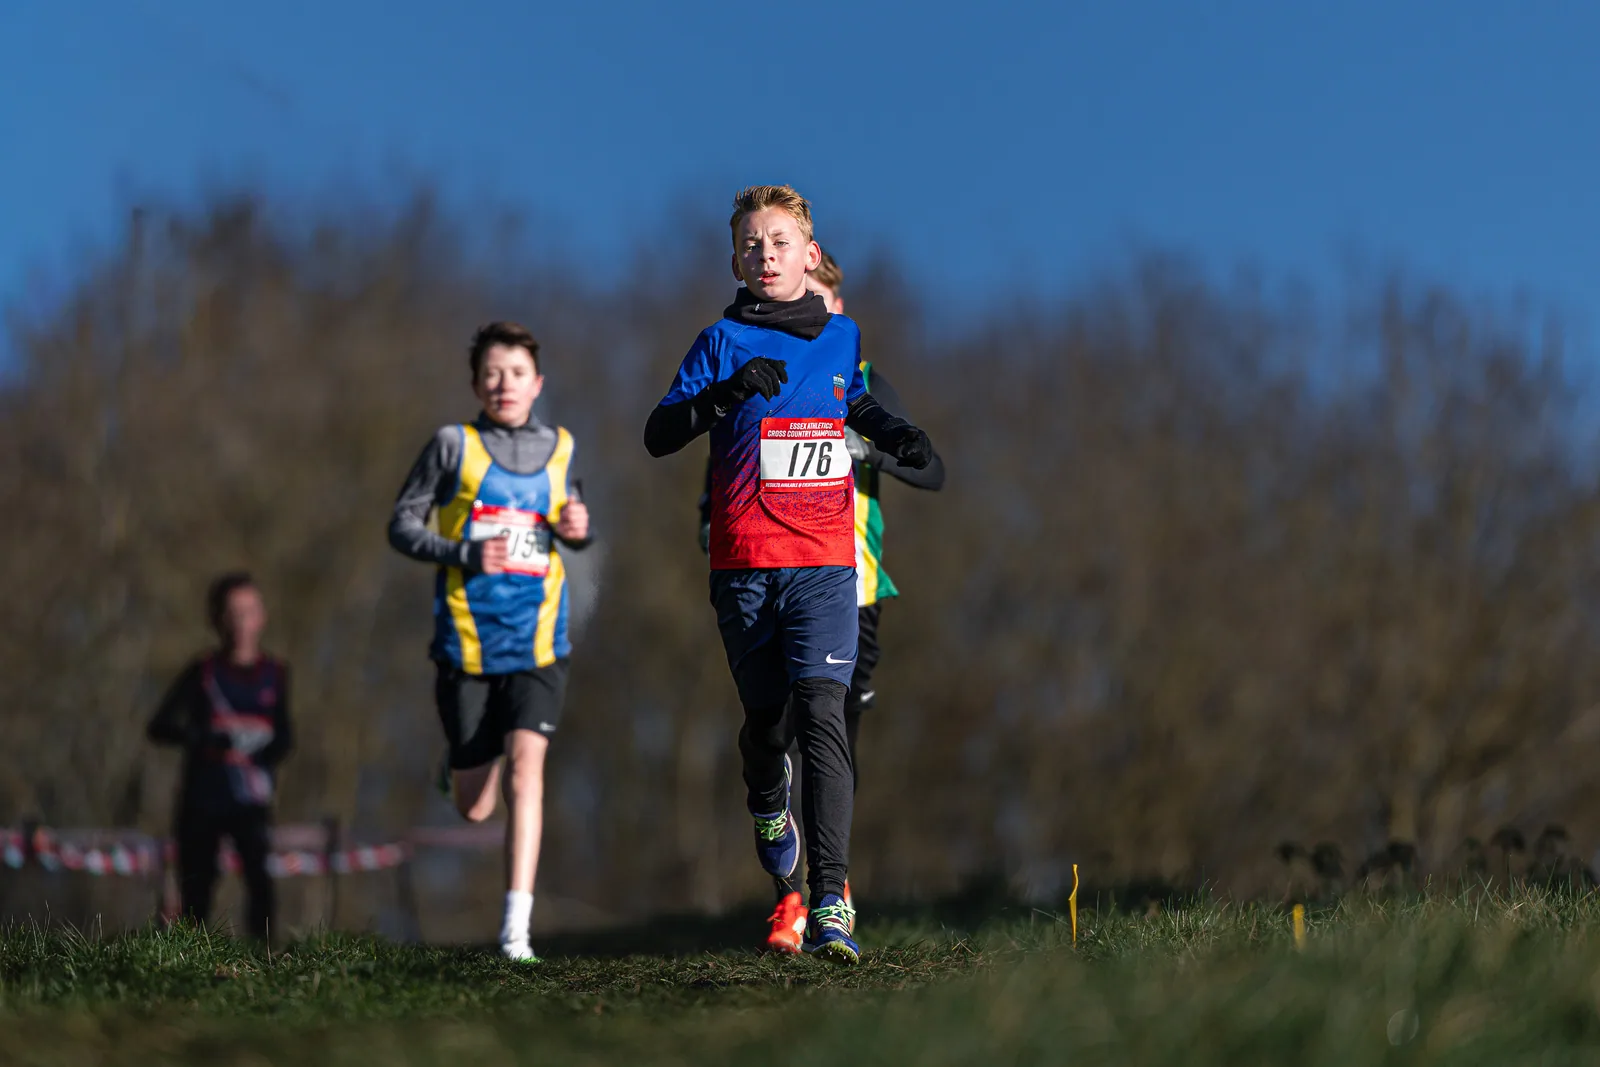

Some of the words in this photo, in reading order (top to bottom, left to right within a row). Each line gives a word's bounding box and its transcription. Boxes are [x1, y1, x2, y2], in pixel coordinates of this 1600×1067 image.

[789, 422, 807, 430] ESSEX
[807, 422, 833, 430] ATHLETICS
[788, 441, 833, 477] 176
